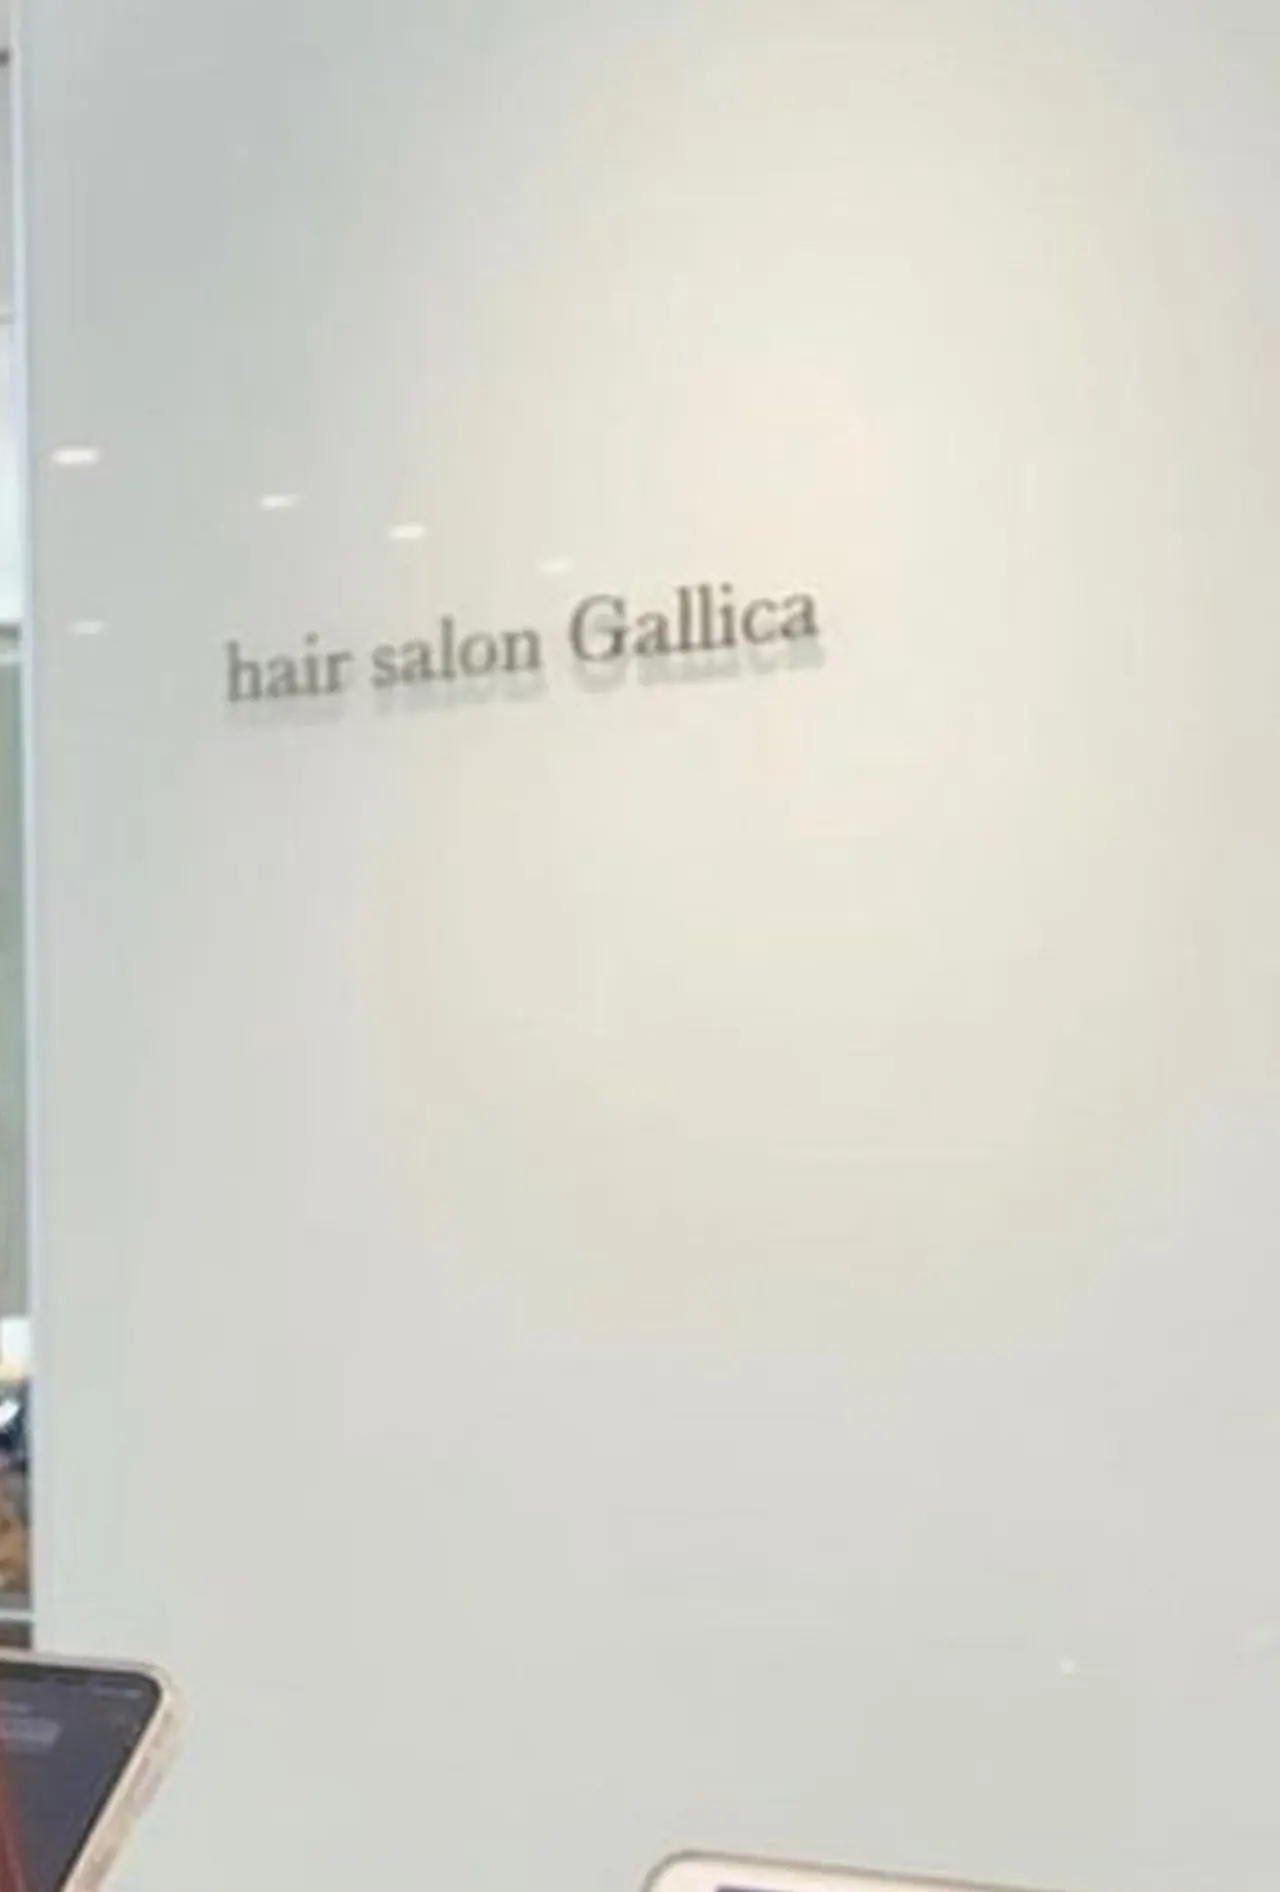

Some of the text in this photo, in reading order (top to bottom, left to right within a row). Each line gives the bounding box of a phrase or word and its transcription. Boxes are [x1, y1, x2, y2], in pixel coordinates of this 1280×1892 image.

[225, 581, 820, 703] hair salon Gallica
